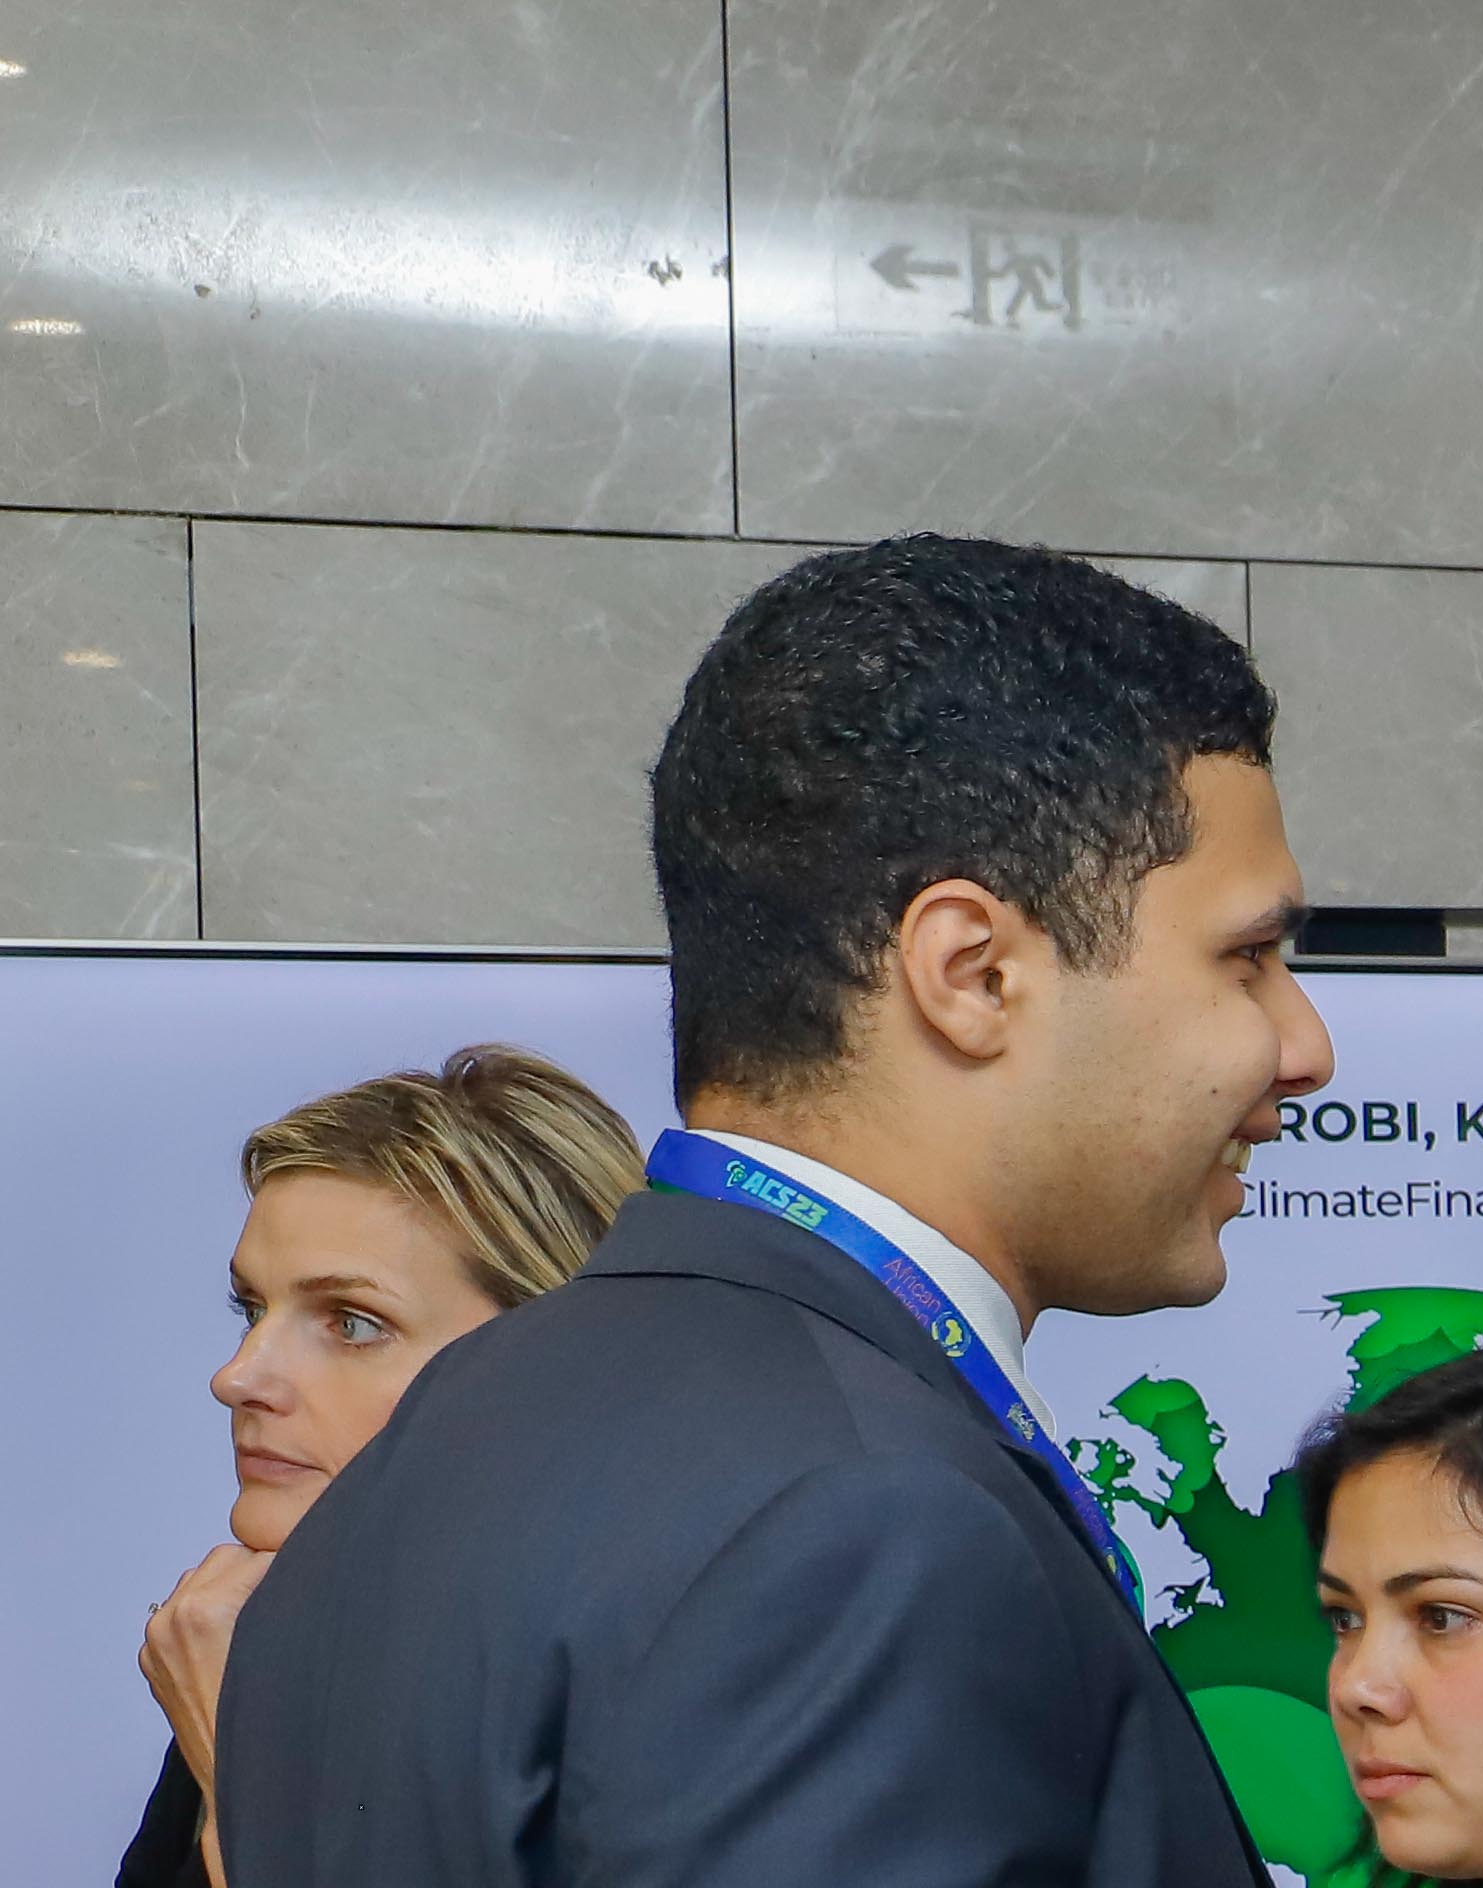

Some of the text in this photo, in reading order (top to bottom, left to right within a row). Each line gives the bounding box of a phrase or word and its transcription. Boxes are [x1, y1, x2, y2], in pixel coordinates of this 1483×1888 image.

[1273, 1101, 1436, 1151] ROBI,
[741, 1170, 828, 1227] ACS23
[882, 1258, 943, 1314] African
